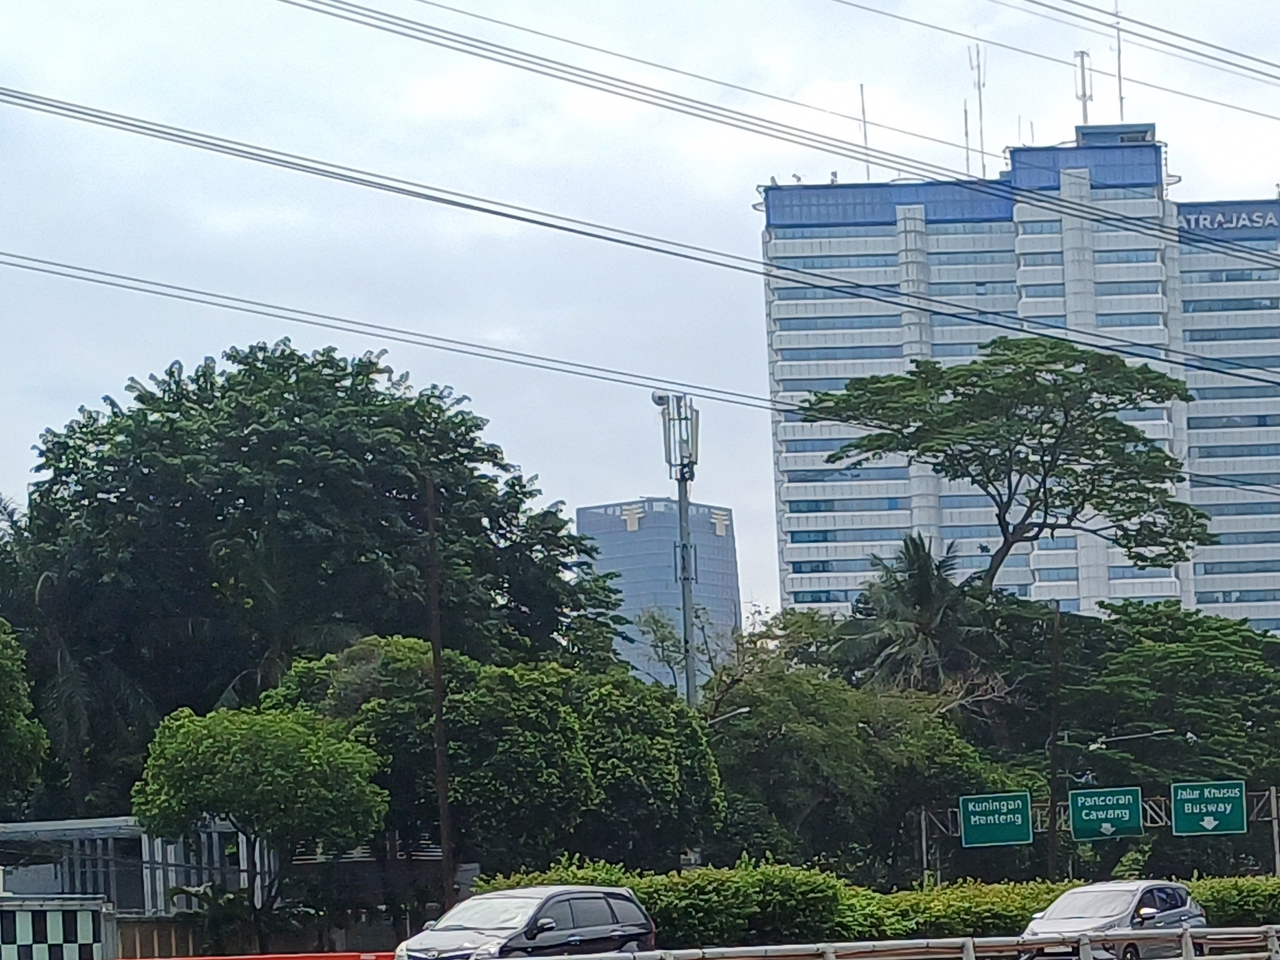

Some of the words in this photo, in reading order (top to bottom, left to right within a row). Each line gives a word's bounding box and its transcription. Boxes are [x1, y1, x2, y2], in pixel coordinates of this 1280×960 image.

[1176, 788, 1201, 800] Jalur
[1203, 787, 1241, 799] Khusus
[968, 799, 1023, 813] Kuningan
[1077, 795, 1133, 808] Pancoran
[1081, 809, 1130, 821] Cawang
[1184, 803, 1232, 814] Busway
